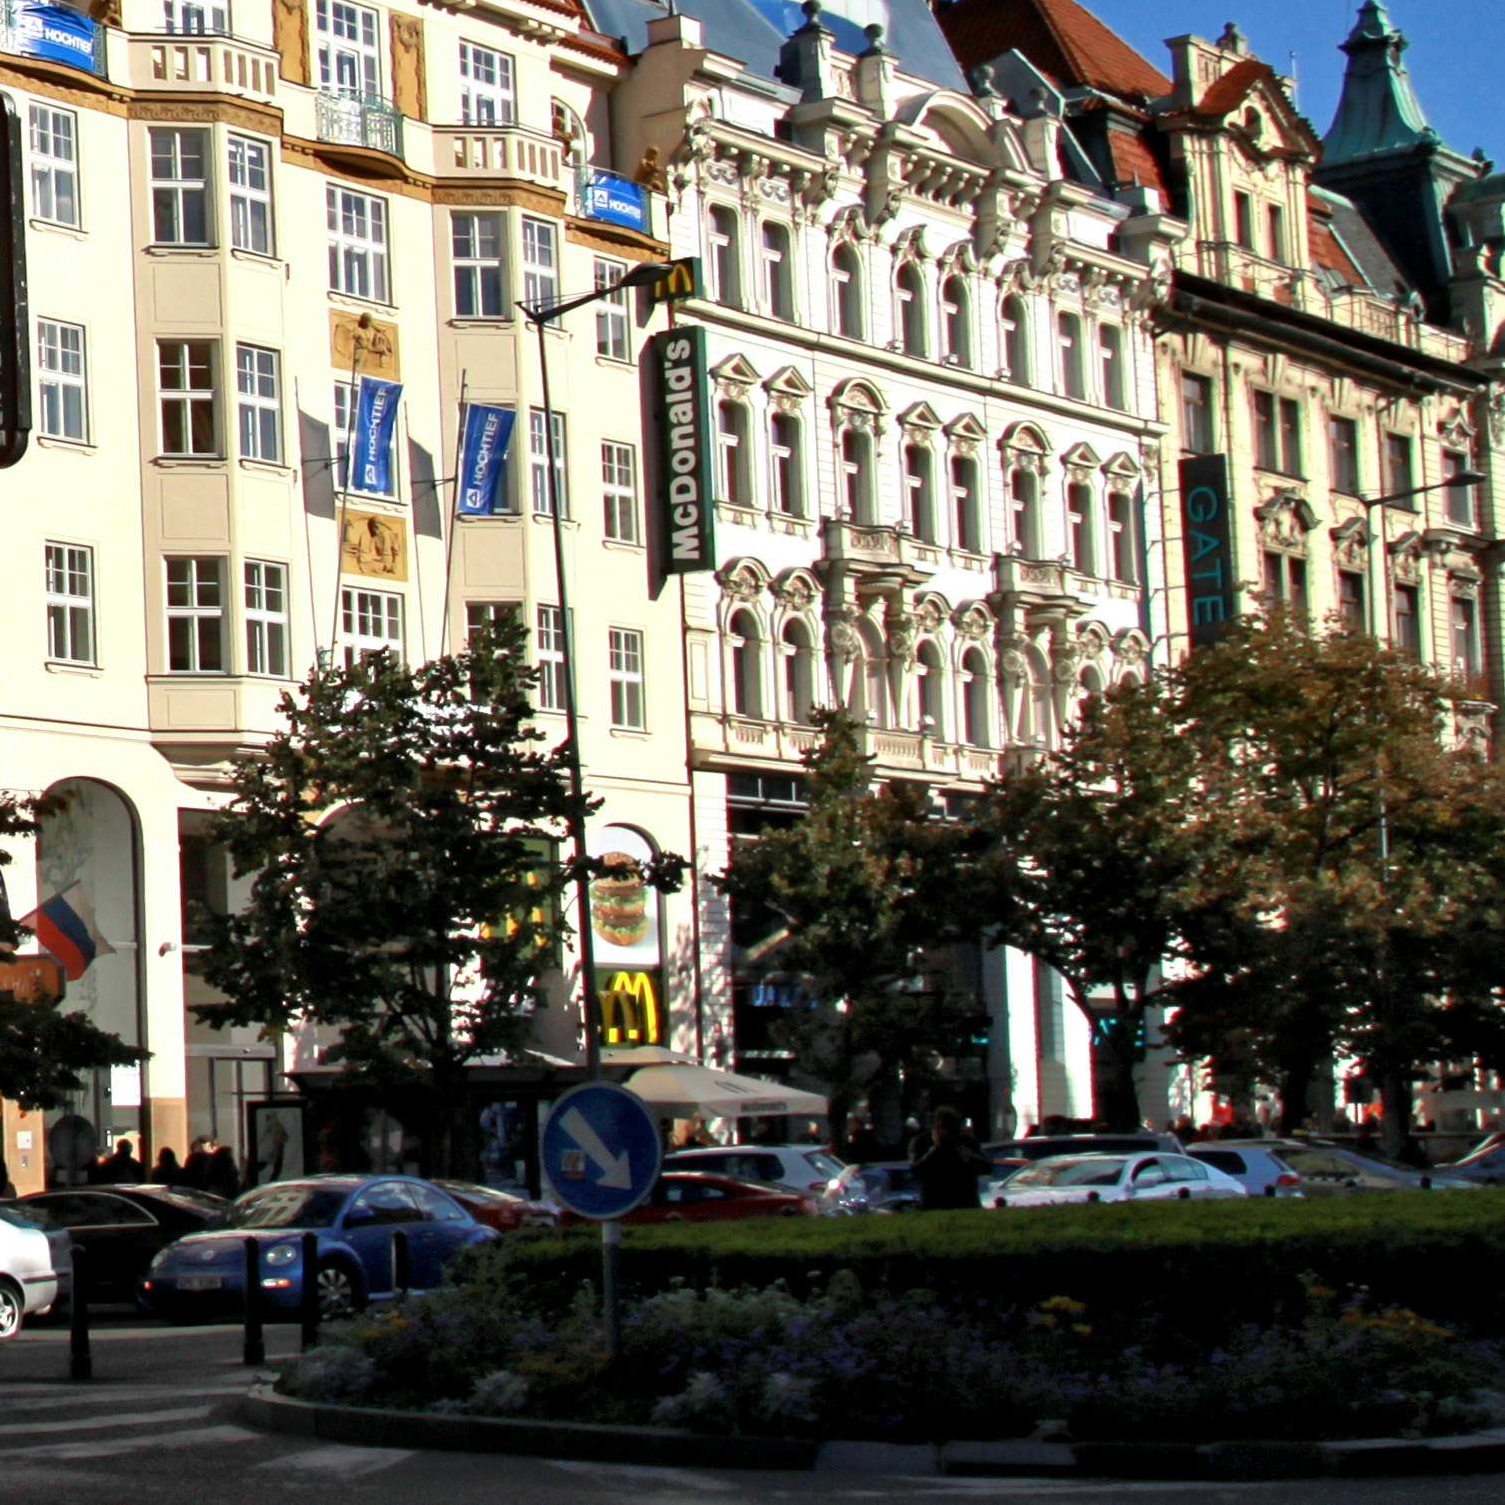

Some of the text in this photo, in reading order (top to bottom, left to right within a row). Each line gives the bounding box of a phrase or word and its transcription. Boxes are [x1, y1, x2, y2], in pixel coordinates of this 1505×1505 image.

[368, 387, 388, 462] HOCHTIEF
[474, 412, 499, 486] HOCHTIEF
[664, 338, 701, 561] McDonald's
[1185, 486, 1225, 626] GATE
